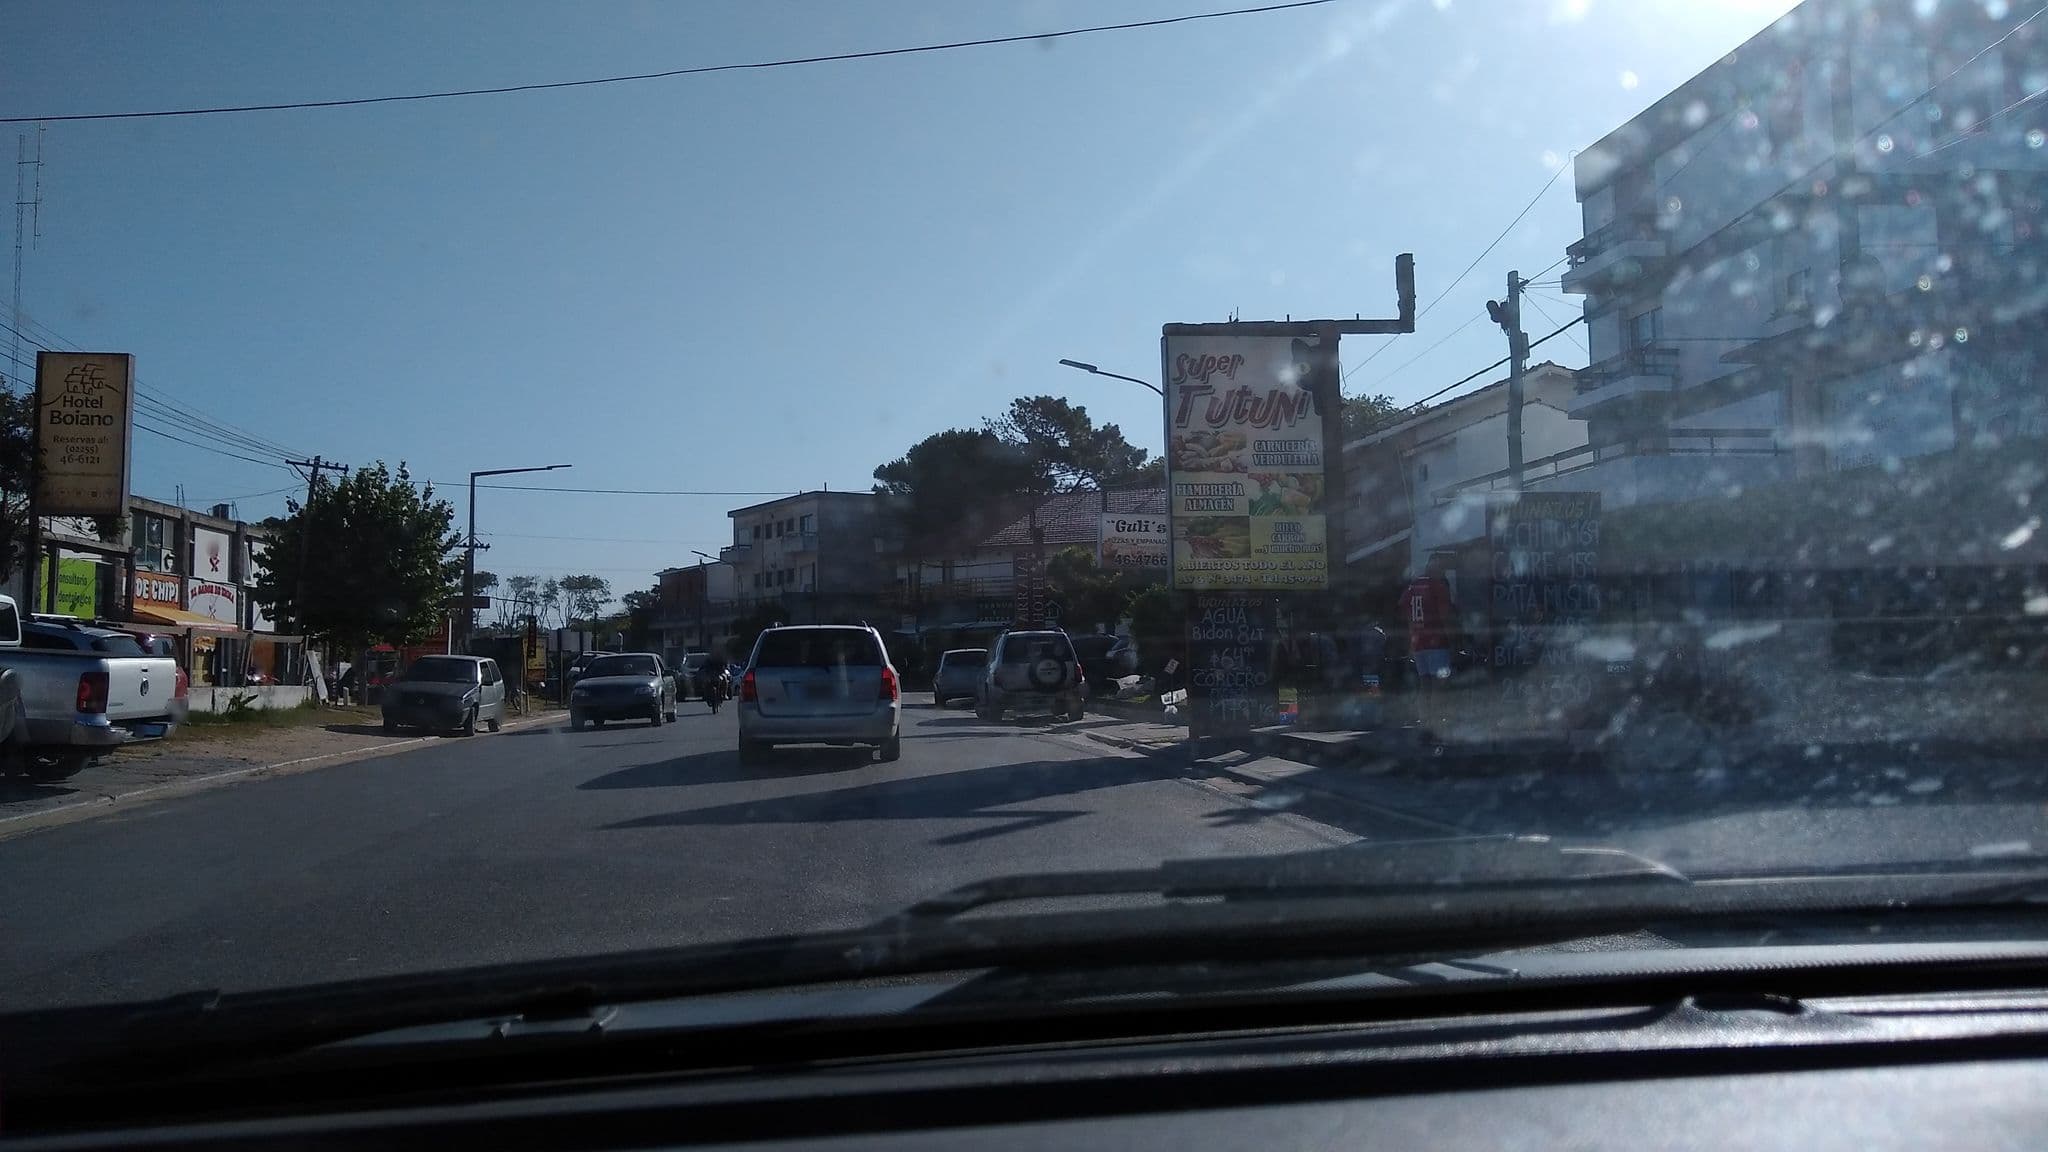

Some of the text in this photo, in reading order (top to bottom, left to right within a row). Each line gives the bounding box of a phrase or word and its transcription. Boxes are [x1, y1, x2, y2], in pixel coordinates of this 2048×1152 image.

[1172, 352, 1245, 384] Super
[63, 395, 104, 409] Hotel
[49, 409, 114, 426] Boiano
[53, 435, 96, 444] Reservas
[60, 454, 101, 465] 46-6121
[1175, 481, 1245, 497] FIAMBRERÍA
[1178, 560, 1240, 571] ABIERTOS
[1241, 560, 1278, 571] TODO
[1279, 560, 1298, 571] EL
[57, 573, 88, 586] onsultorio
[135, 577, 179, 604] DE CHIPI
[1201, 607, 1248, 624] AGUA
